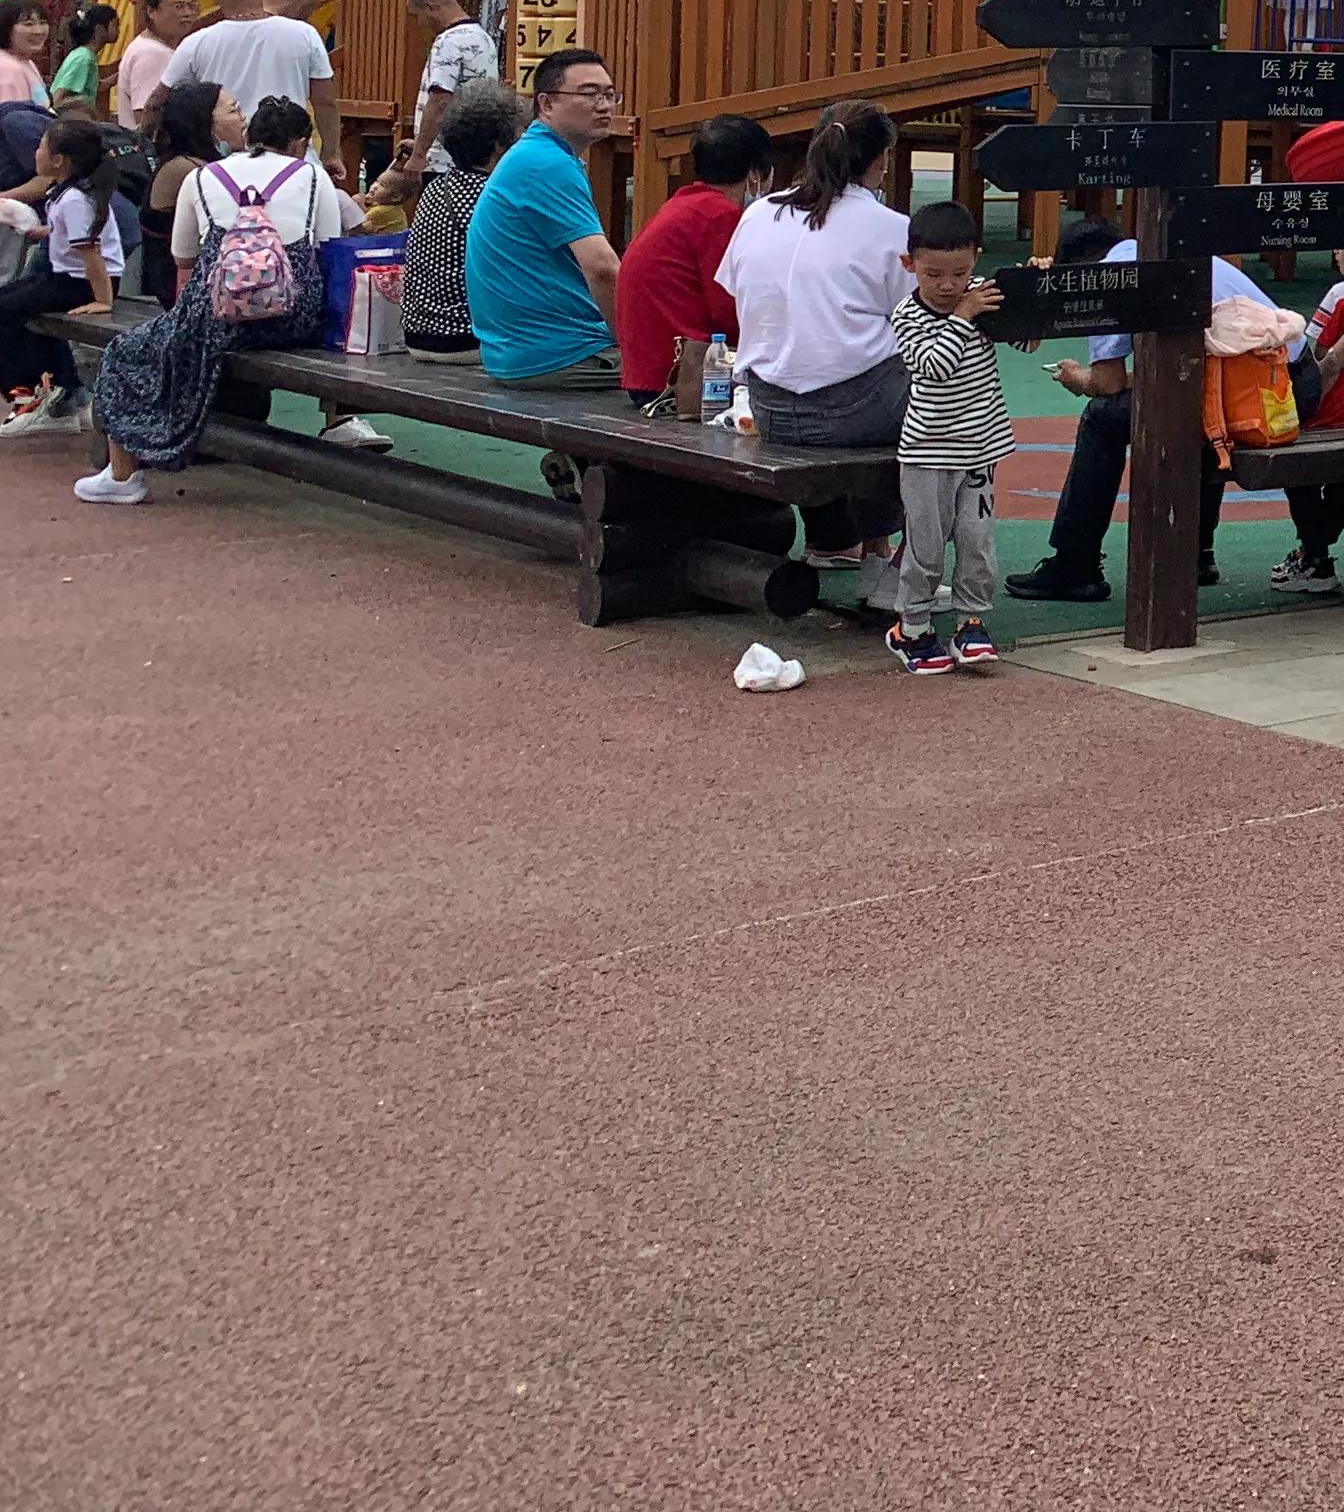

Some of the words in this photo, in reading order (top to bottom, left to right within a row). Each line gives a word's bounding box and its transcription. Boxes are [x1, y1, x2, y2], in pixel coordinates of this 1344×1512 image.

[1261, 59, 1336, 81] 医疗室
[1267, 103, 1299, 117] Medical
[1300, 103, 1324, 117] Room
[1065, 128, 1146, 152] 卡丁车
[1078, 173, 1131, 186] Karting
[1256, 189, 1329, 212] 母婴室
[1261, 235, 1293, 248] Nursing
[1293, 234, 1317, 244] Room
[1037, 268, 1139, 296] 水生植物园
